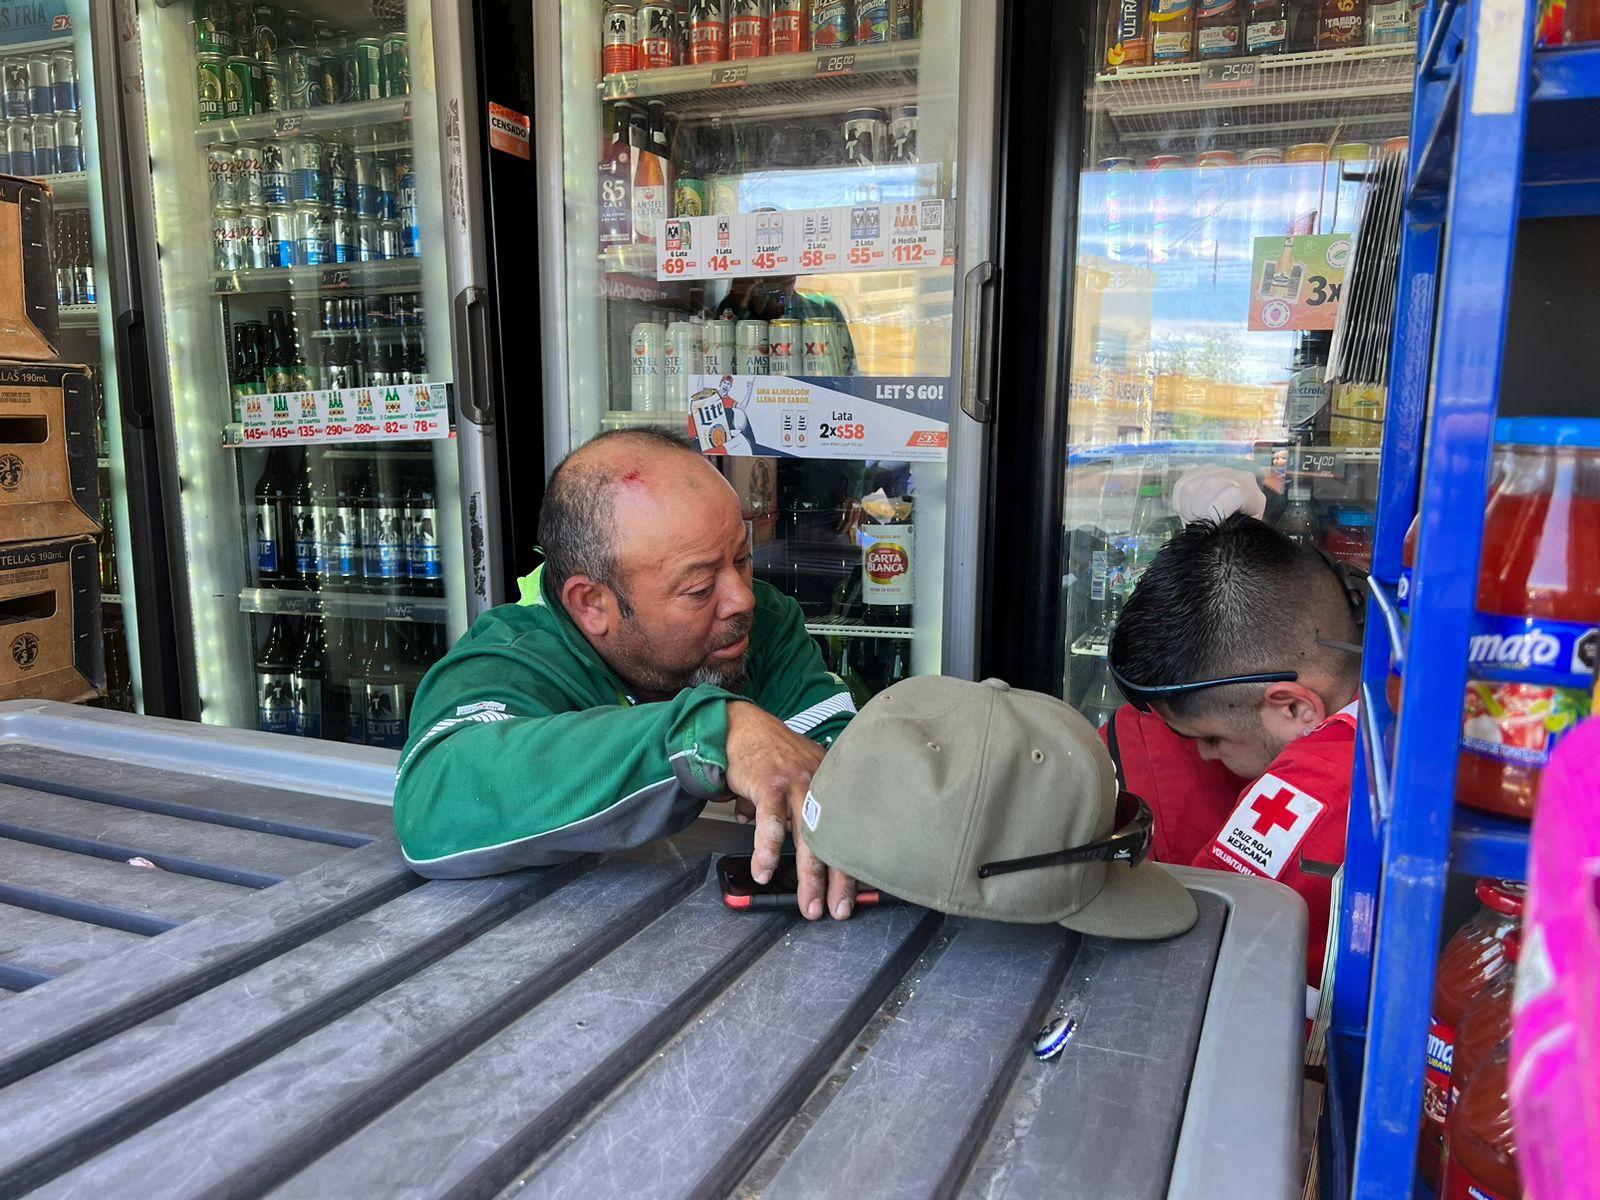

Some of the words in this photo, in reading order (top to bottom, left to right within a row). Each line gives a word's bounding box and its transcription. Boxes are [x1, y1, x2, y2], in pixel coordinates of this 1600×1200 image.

[15, 2, 46, 27] FRÍA
[491, 117, 526, 138] CENSADO
[602, 180, 626, 201] 85
[22, 373, 48, 382] 190mL
[771, 388, 810, 396] ALINEACIÓN
[917, 385, 944, 401] GO!
[698, 402, 724, 426] Lite
[832, 411, 853, 421] Lata
[820, 423, 865, 440] 2x$58
[39, 551, 64, 560] 190mL
[868, 553, 902, 564] CARTA
[867, 563, 904, 572] BLANCA
[1227, 835, 1267, 867] MEXICANA
[1232, 828, 1252, 844] CRUZ
[1250, 839, 1273, 858] ROJA
